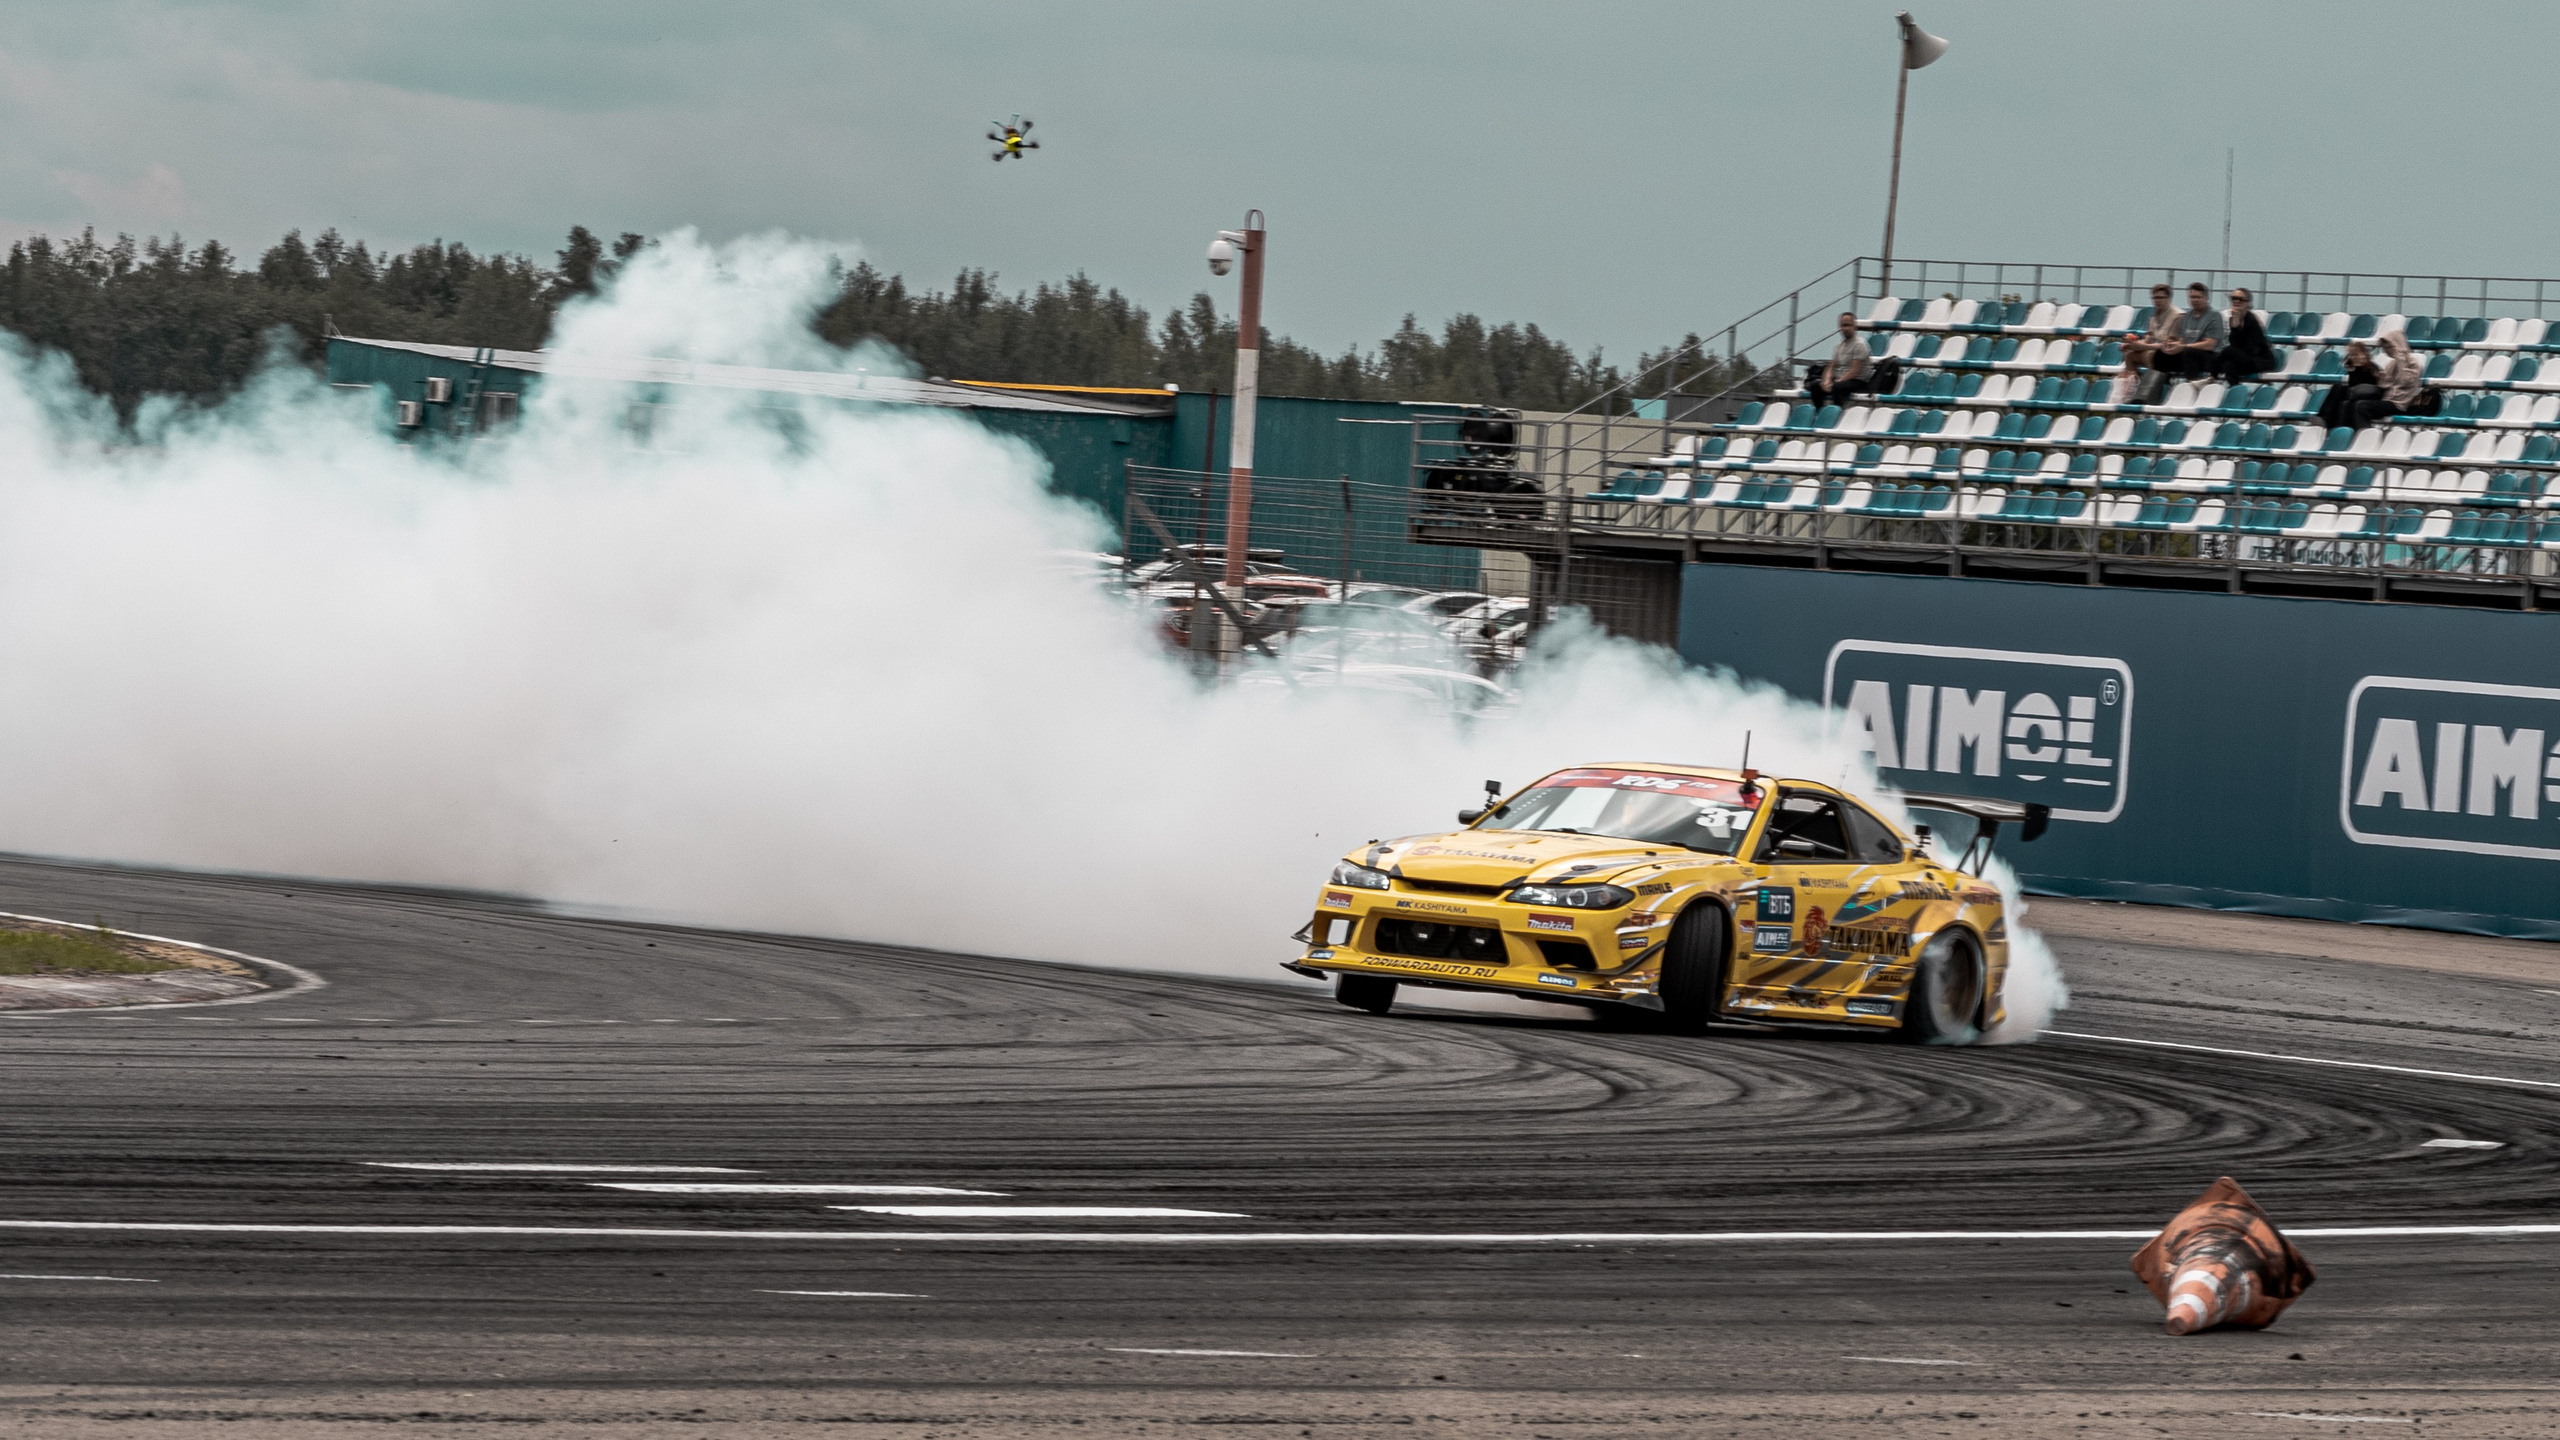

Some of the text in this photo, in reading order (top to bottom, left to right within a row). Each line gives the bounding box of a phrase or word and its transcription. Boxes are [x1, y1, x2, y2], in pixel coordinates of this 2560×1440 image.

[1845, 680, 2112, 786] AIMOL
[2355, 718, 2560, 821] AIM
[1612, 775, 1690, 789] RDS
[1696, 808, 1754, 830] 31
[1443, 849, 1537, 865] TAKAYAMA
[1636, 882, 1674, 896] MAHLE
[1414, 902, 1468, 914] KASHIYAMA
[1528, 918, 1573, 931] makita
[1829, 925, 1911, 957] TAKAYAMA
[1361, 957, 1498, 978] FORWARDAUTO.RU
